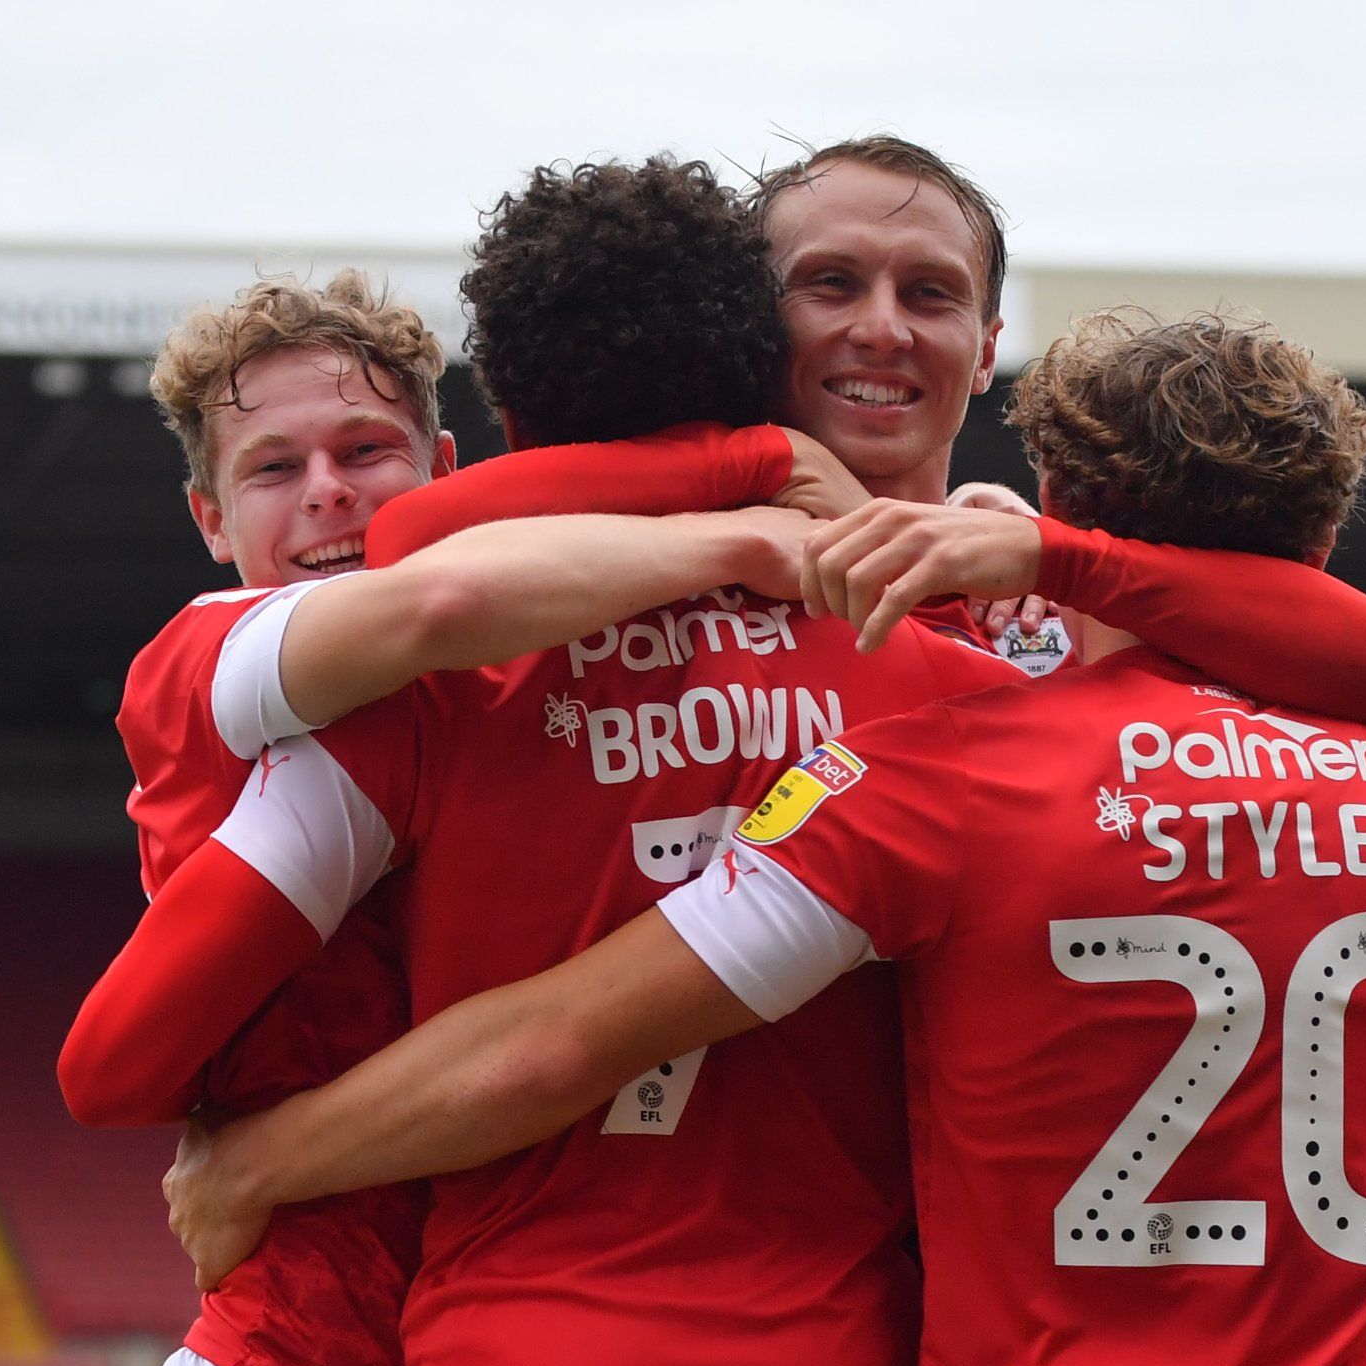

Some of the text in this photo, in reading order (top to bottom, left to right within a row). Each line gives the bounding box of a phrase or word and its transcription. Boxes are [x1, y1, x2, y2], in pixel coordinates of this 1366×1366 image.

[587, 683, 844, 785] BROWN
[812, 754, 849, 786] bet
[640, 1110, 663, 1123] EFL
[1149, 1243, 1171, 1255] EFL
